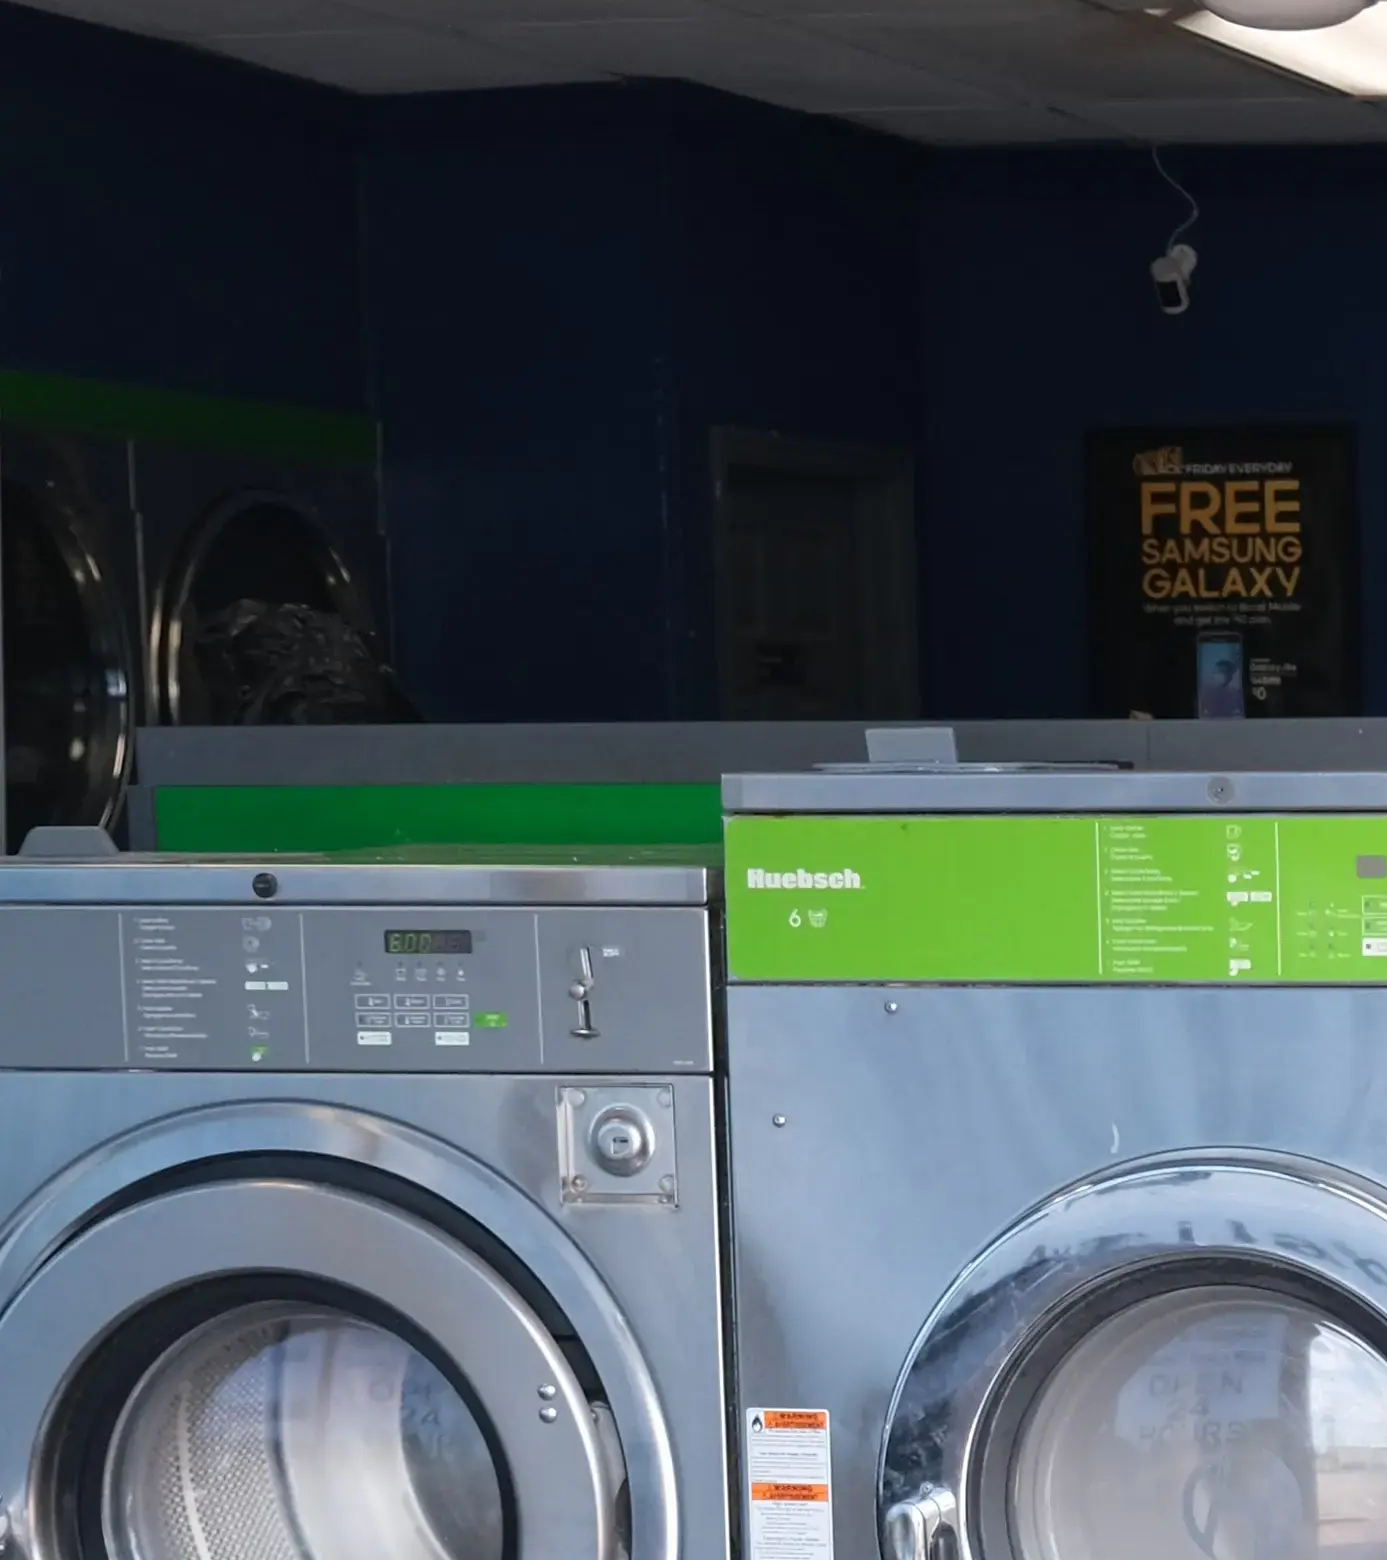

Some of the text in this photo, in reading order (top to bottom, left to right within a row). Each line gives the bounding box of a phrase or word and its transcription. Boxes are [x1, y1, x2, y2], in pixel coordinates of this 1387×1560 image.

[1141, 479, 1300, 535] FREE
[1141, 537, 1302, 565] SAMSUNG
[1142, 566, 1301, 598] GALAXY
[747, 868, 861, 889] Huebsch
[789, 908, 801, 928] 6
